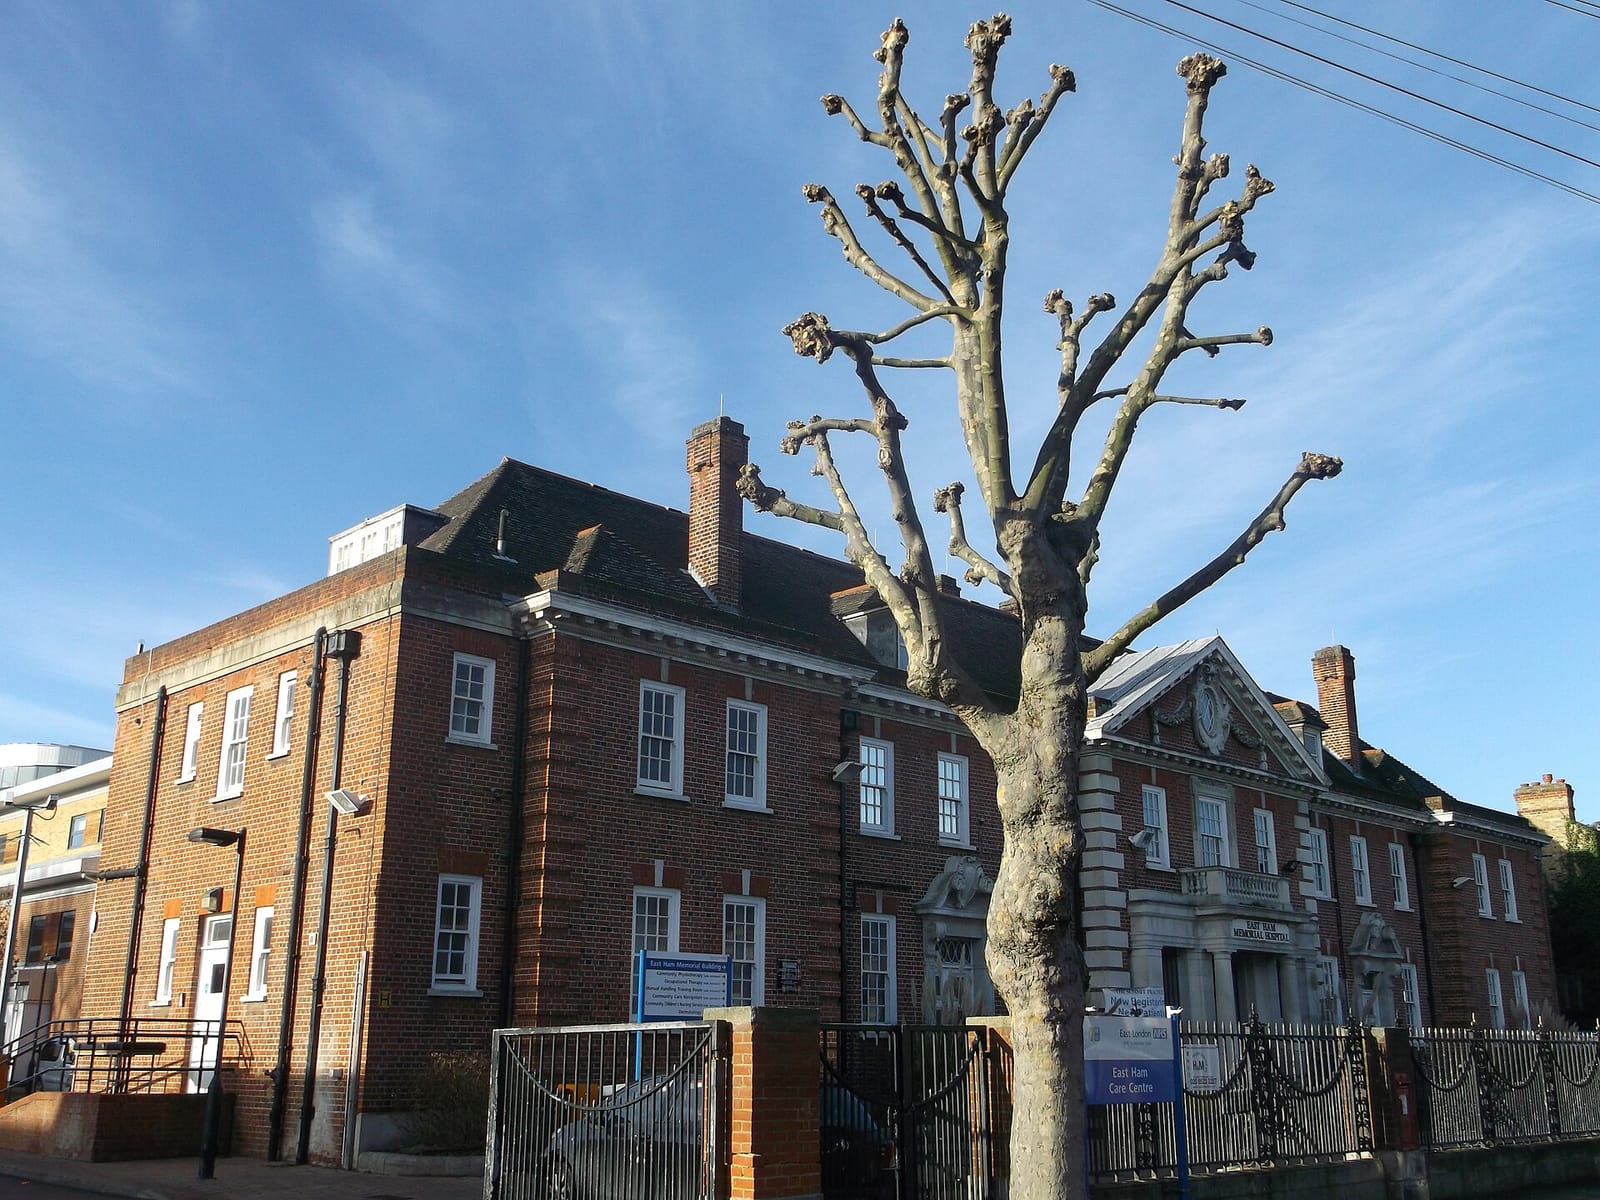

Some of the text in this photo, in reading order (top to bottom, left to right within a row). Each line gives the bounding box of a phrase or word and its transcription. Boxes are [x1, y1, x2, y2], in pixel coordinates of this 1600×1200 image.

[1246, 921, 1276, 932] EAST HAM
[1234, 928, 1288, 941] MEMORIAL HOSPITAL
[676, 961, 700, 969] Memorial
[702, 962, 721, 971] Building
[1120, 1028, 1167, 1039] East London NHS
[1112, 1068, 1148, 1078] East Ham
[1109, 1083, 1153, 1094] Care Centre
